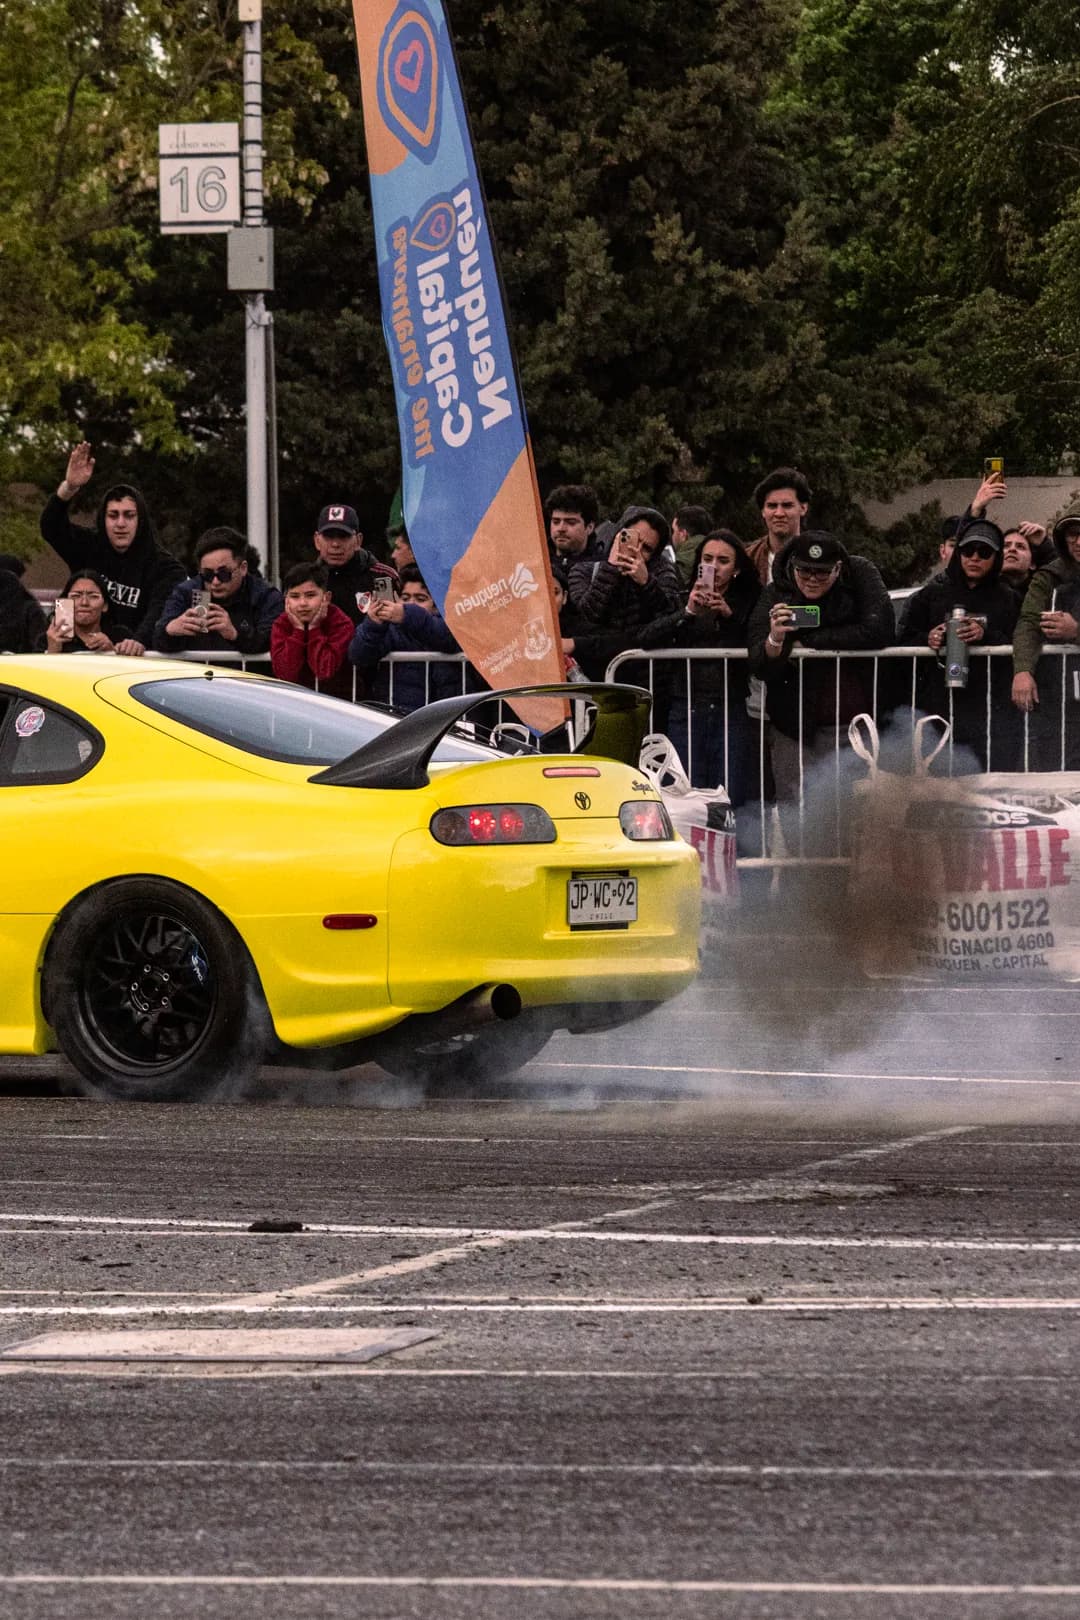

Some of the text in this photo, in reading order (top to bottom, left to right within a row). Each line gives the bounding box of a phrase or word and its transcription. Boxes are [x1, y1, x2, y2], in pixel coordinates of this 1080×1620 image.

[169, 165, 228, 213] 16
[943, 936, 1012, 956] IGNACIO
[1016, 931, 1055, 950] 4600
[992, 953, 1049, 970] CAPITAL
